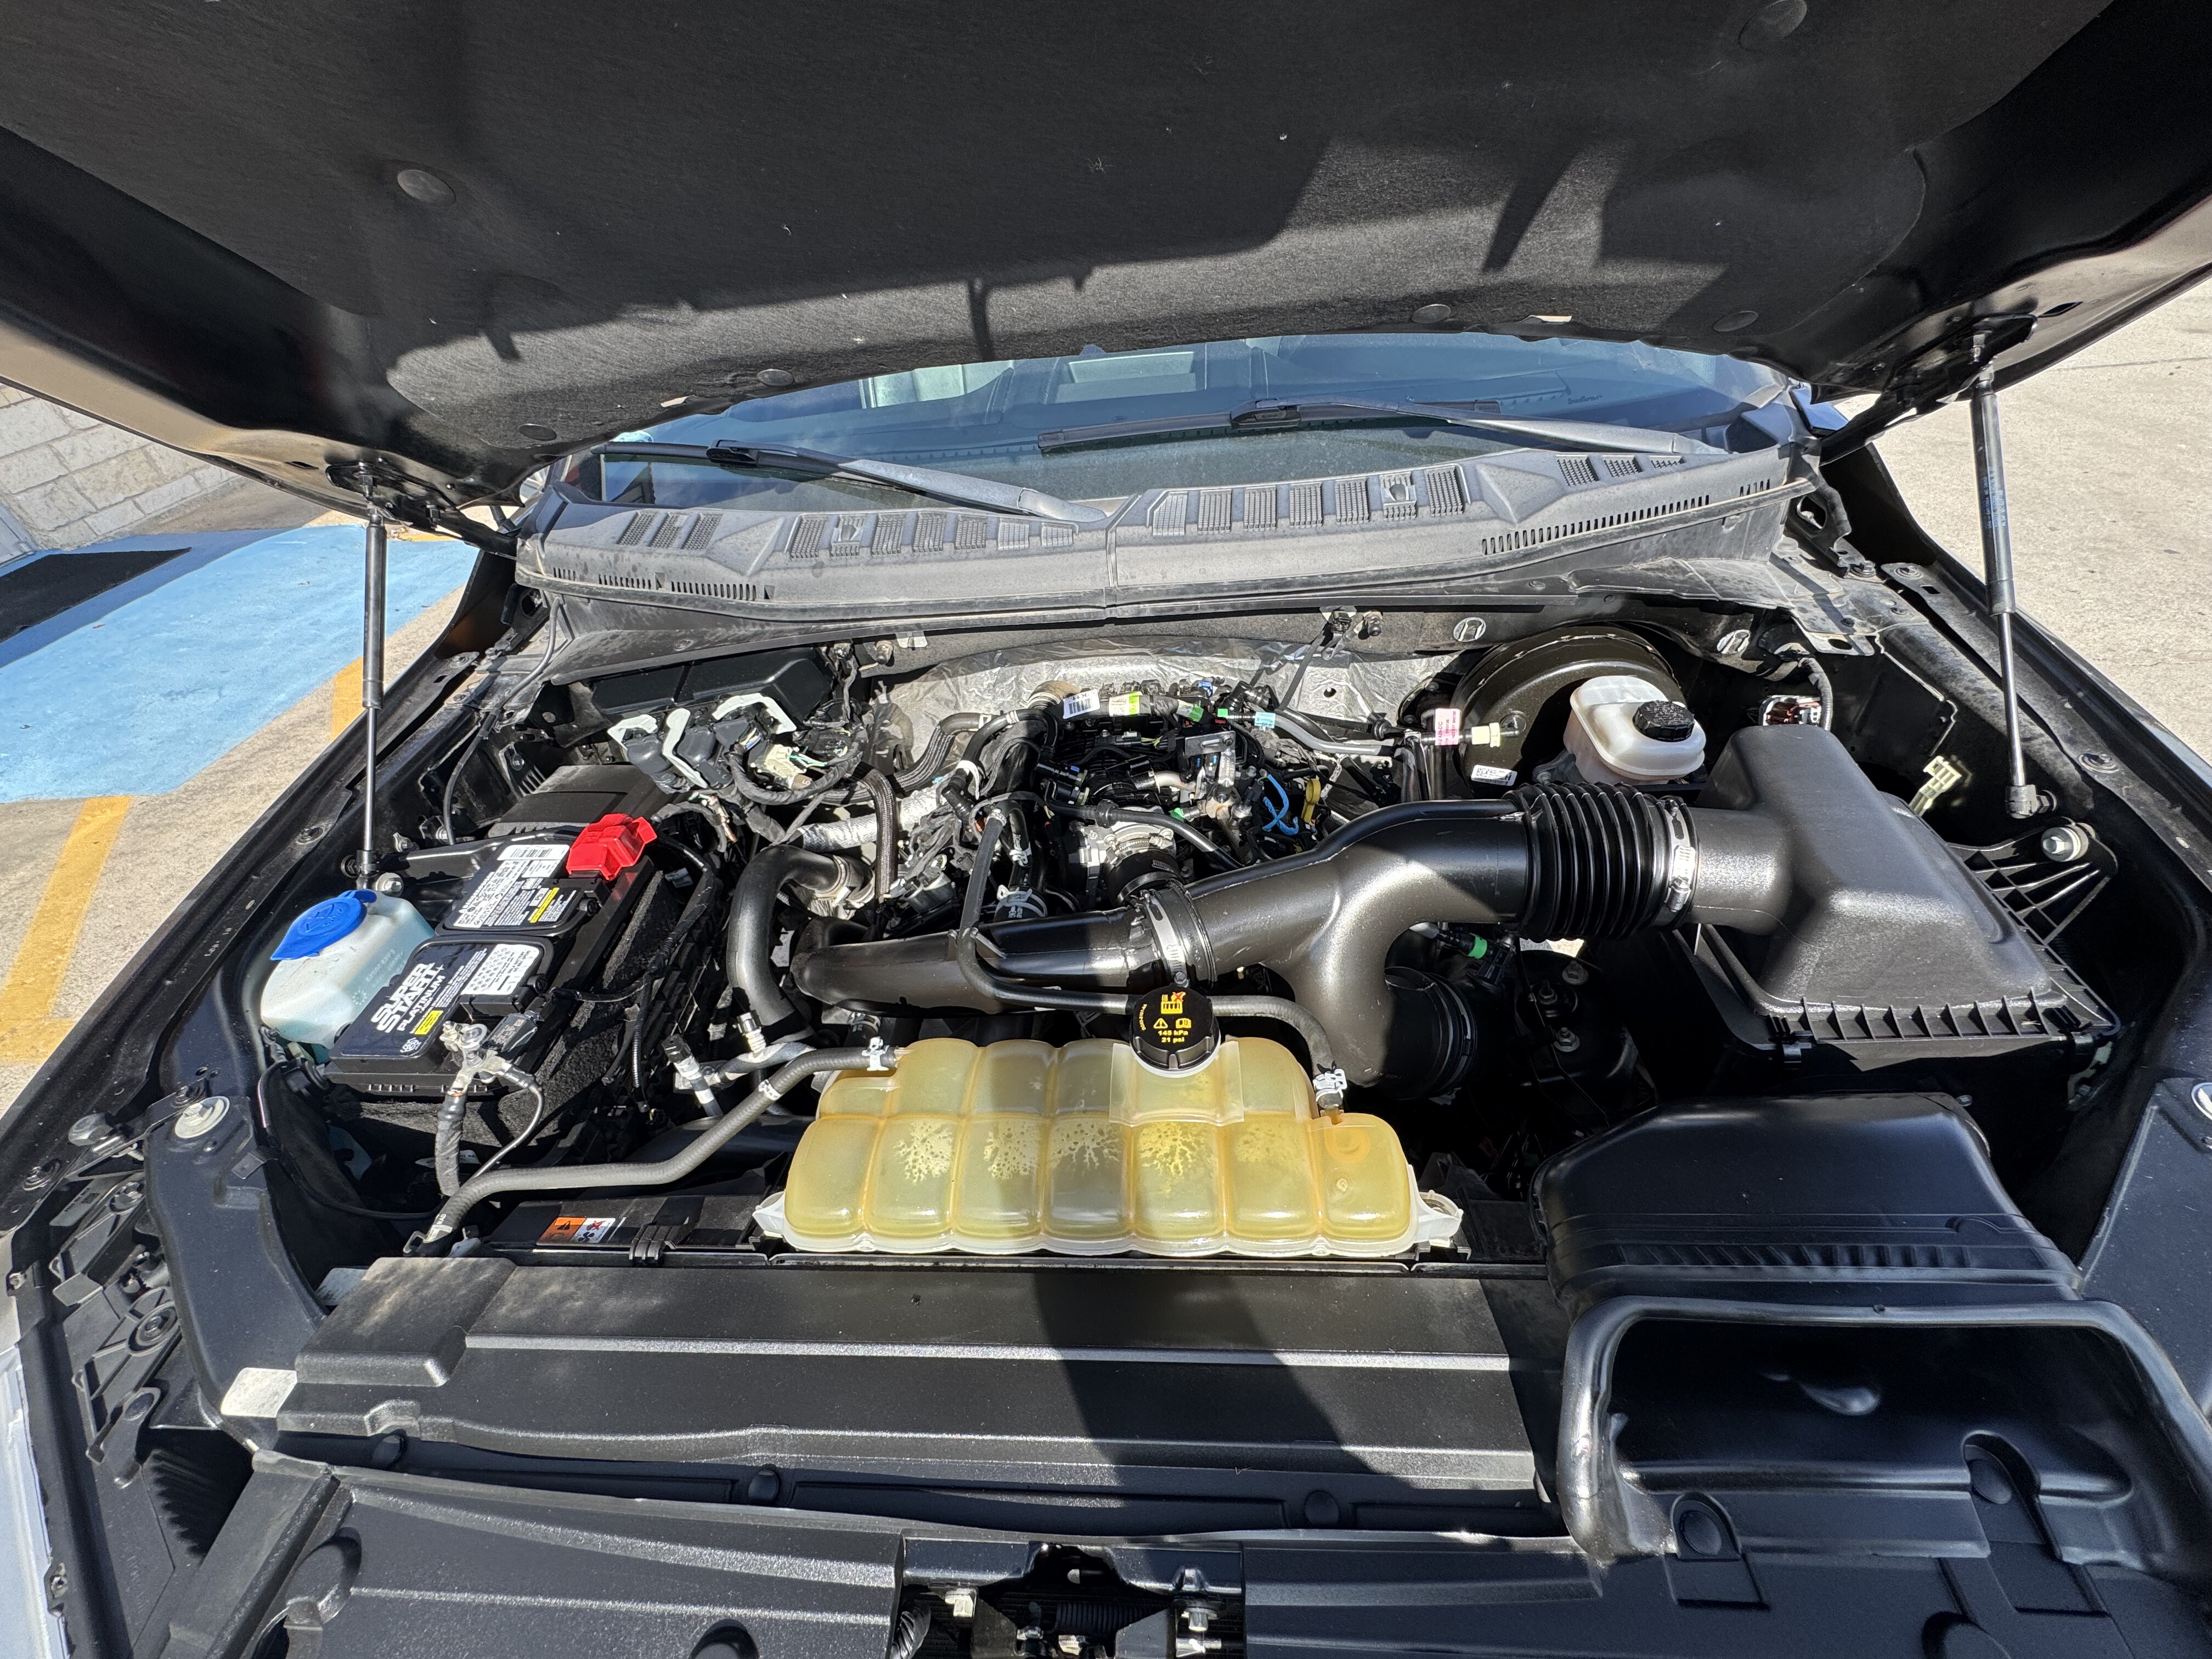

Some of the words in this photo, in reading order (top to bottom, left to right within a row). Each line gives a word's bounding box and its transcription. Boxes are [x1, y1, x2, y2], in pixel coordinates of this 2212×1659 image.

[371, 963, 428, 1023] SUPER
[376, 963, 436, 1034] START
[397, 975, 446, 1031] PLATINUM
